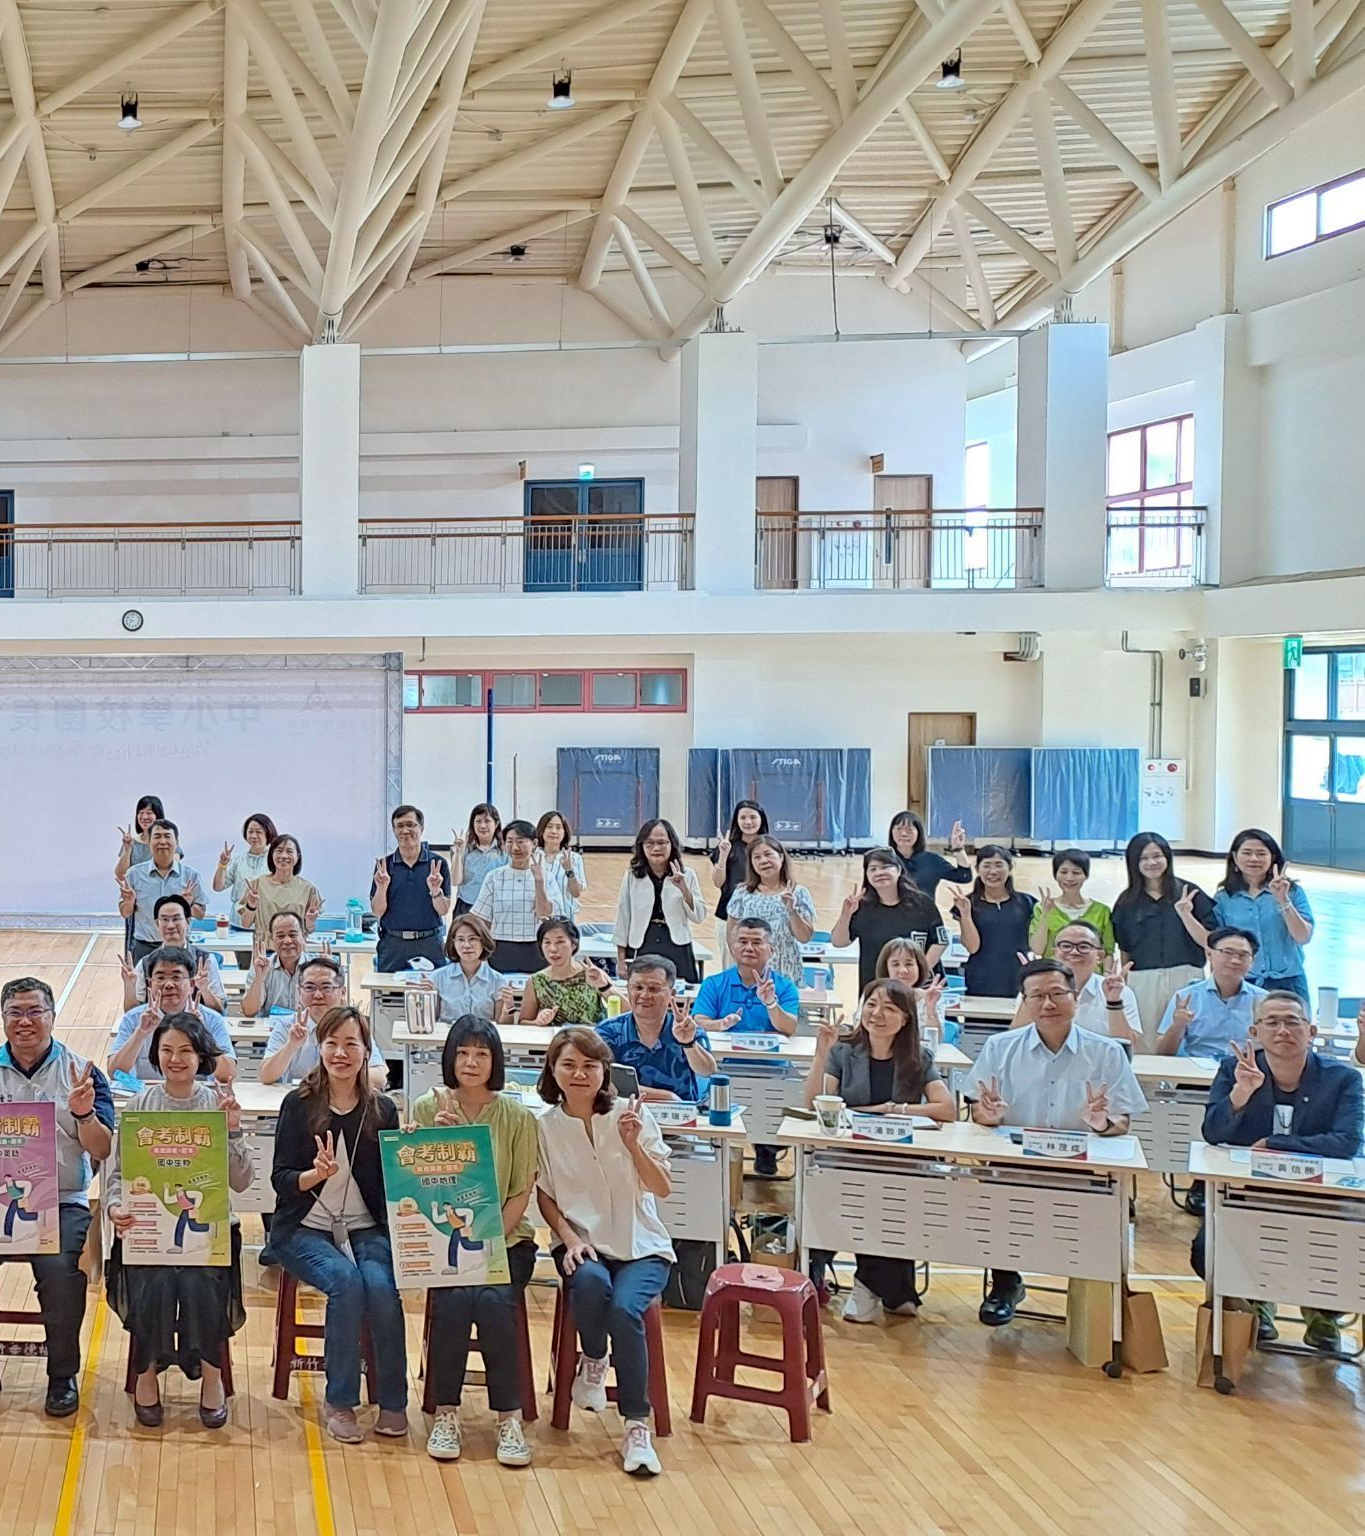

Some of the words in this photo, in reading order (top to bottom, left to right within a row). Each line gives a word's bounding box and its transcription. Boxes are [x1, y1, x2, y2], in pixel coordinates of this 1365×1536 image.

[137, 1126, 212, 1147] 會考制霸
[157, 1159, 191, 1167] 國中生物
[397, 1141, 477, 1167] 會考制霸
